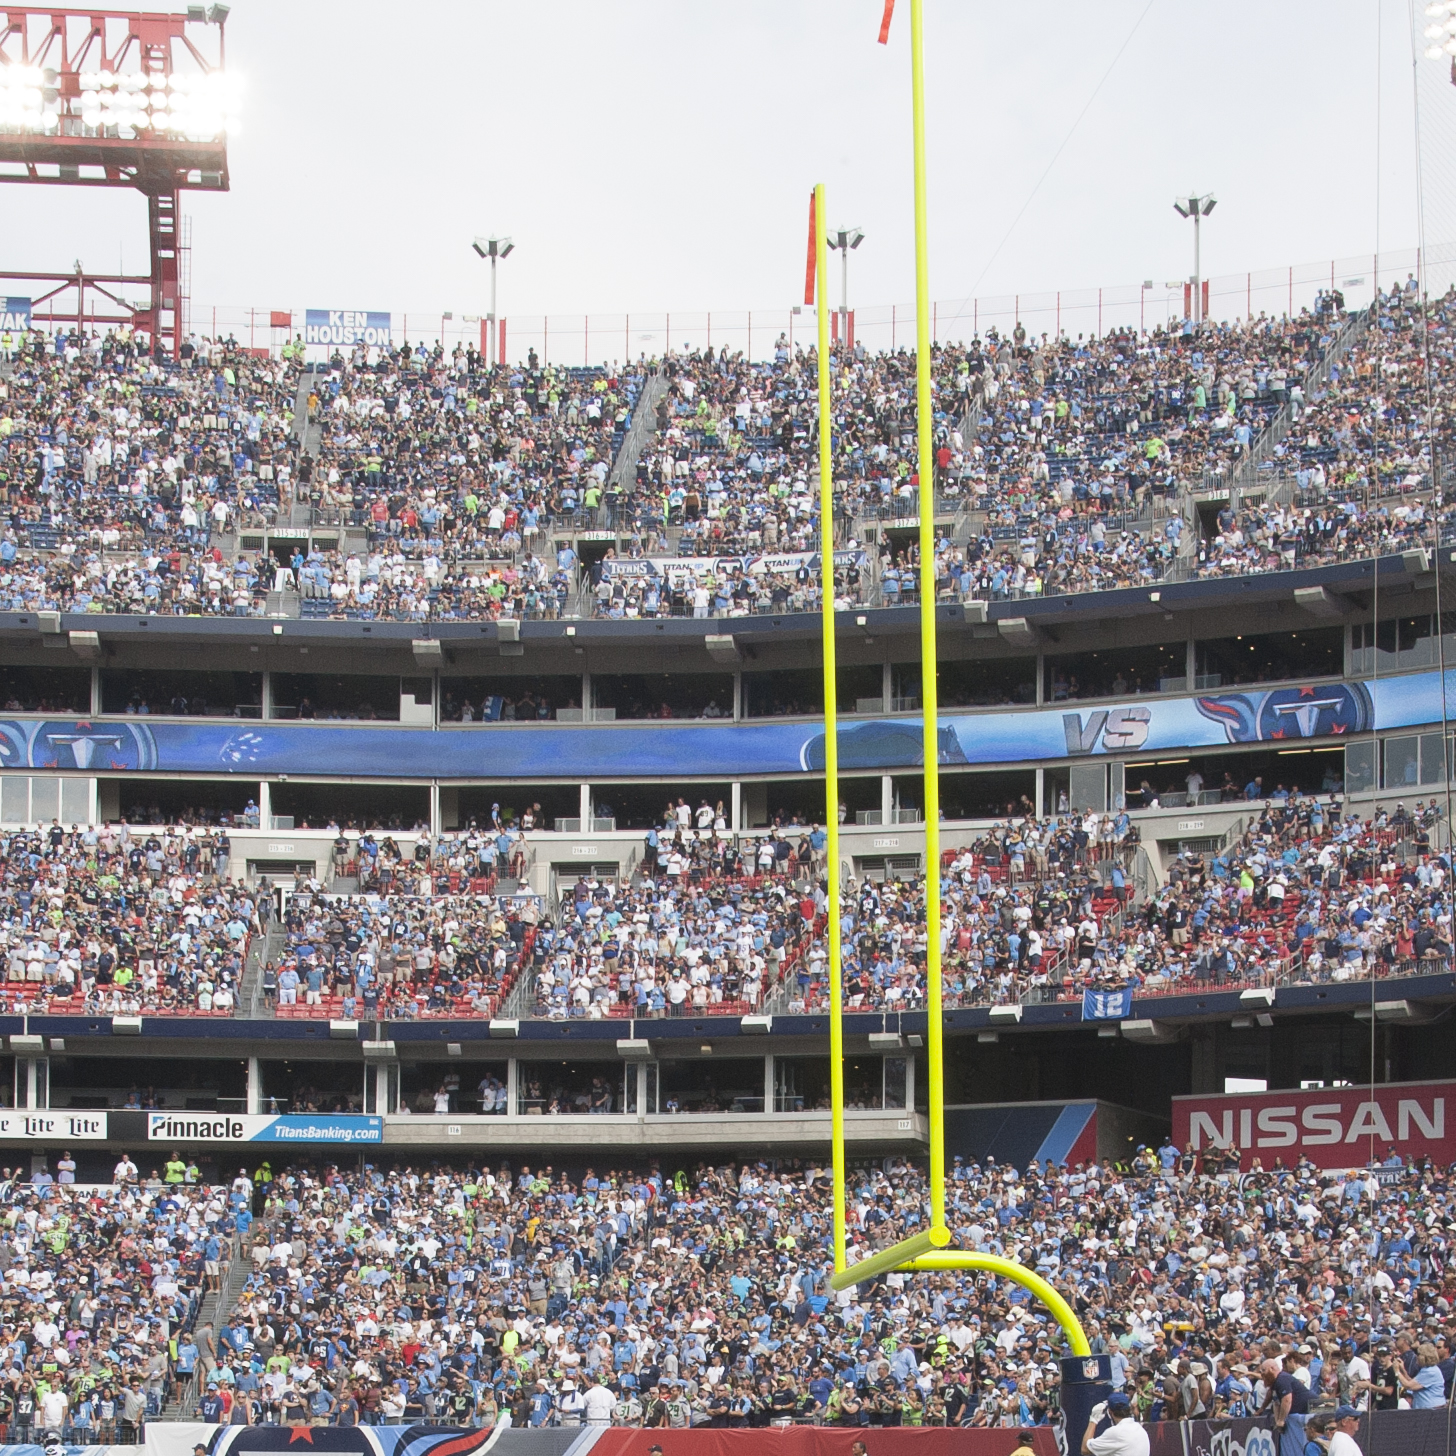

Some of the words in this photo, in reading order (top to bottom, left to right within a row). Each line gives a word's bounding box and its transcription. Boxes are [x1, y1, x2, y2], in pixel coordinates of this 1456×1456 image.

[329, 311, 367, 327] KEN
[307, 326, 389, 346] HOUSTON
[1062, 706, 1152, 755] VS
[1094, 993, 1124, 1017] 12
[25, 1117, 54, 1135] Lite
[69, 1118, 99, 1136] Lite
[152, 1116, 243, 1138] Pinnacle
[275, 1125, 379, 1141] TitansBanking.com
[1190, 1098, 1445, 1150] NISSAN
[19, 1402, 31, 1414] 37
[203, 1403, 217, 1415] 27
